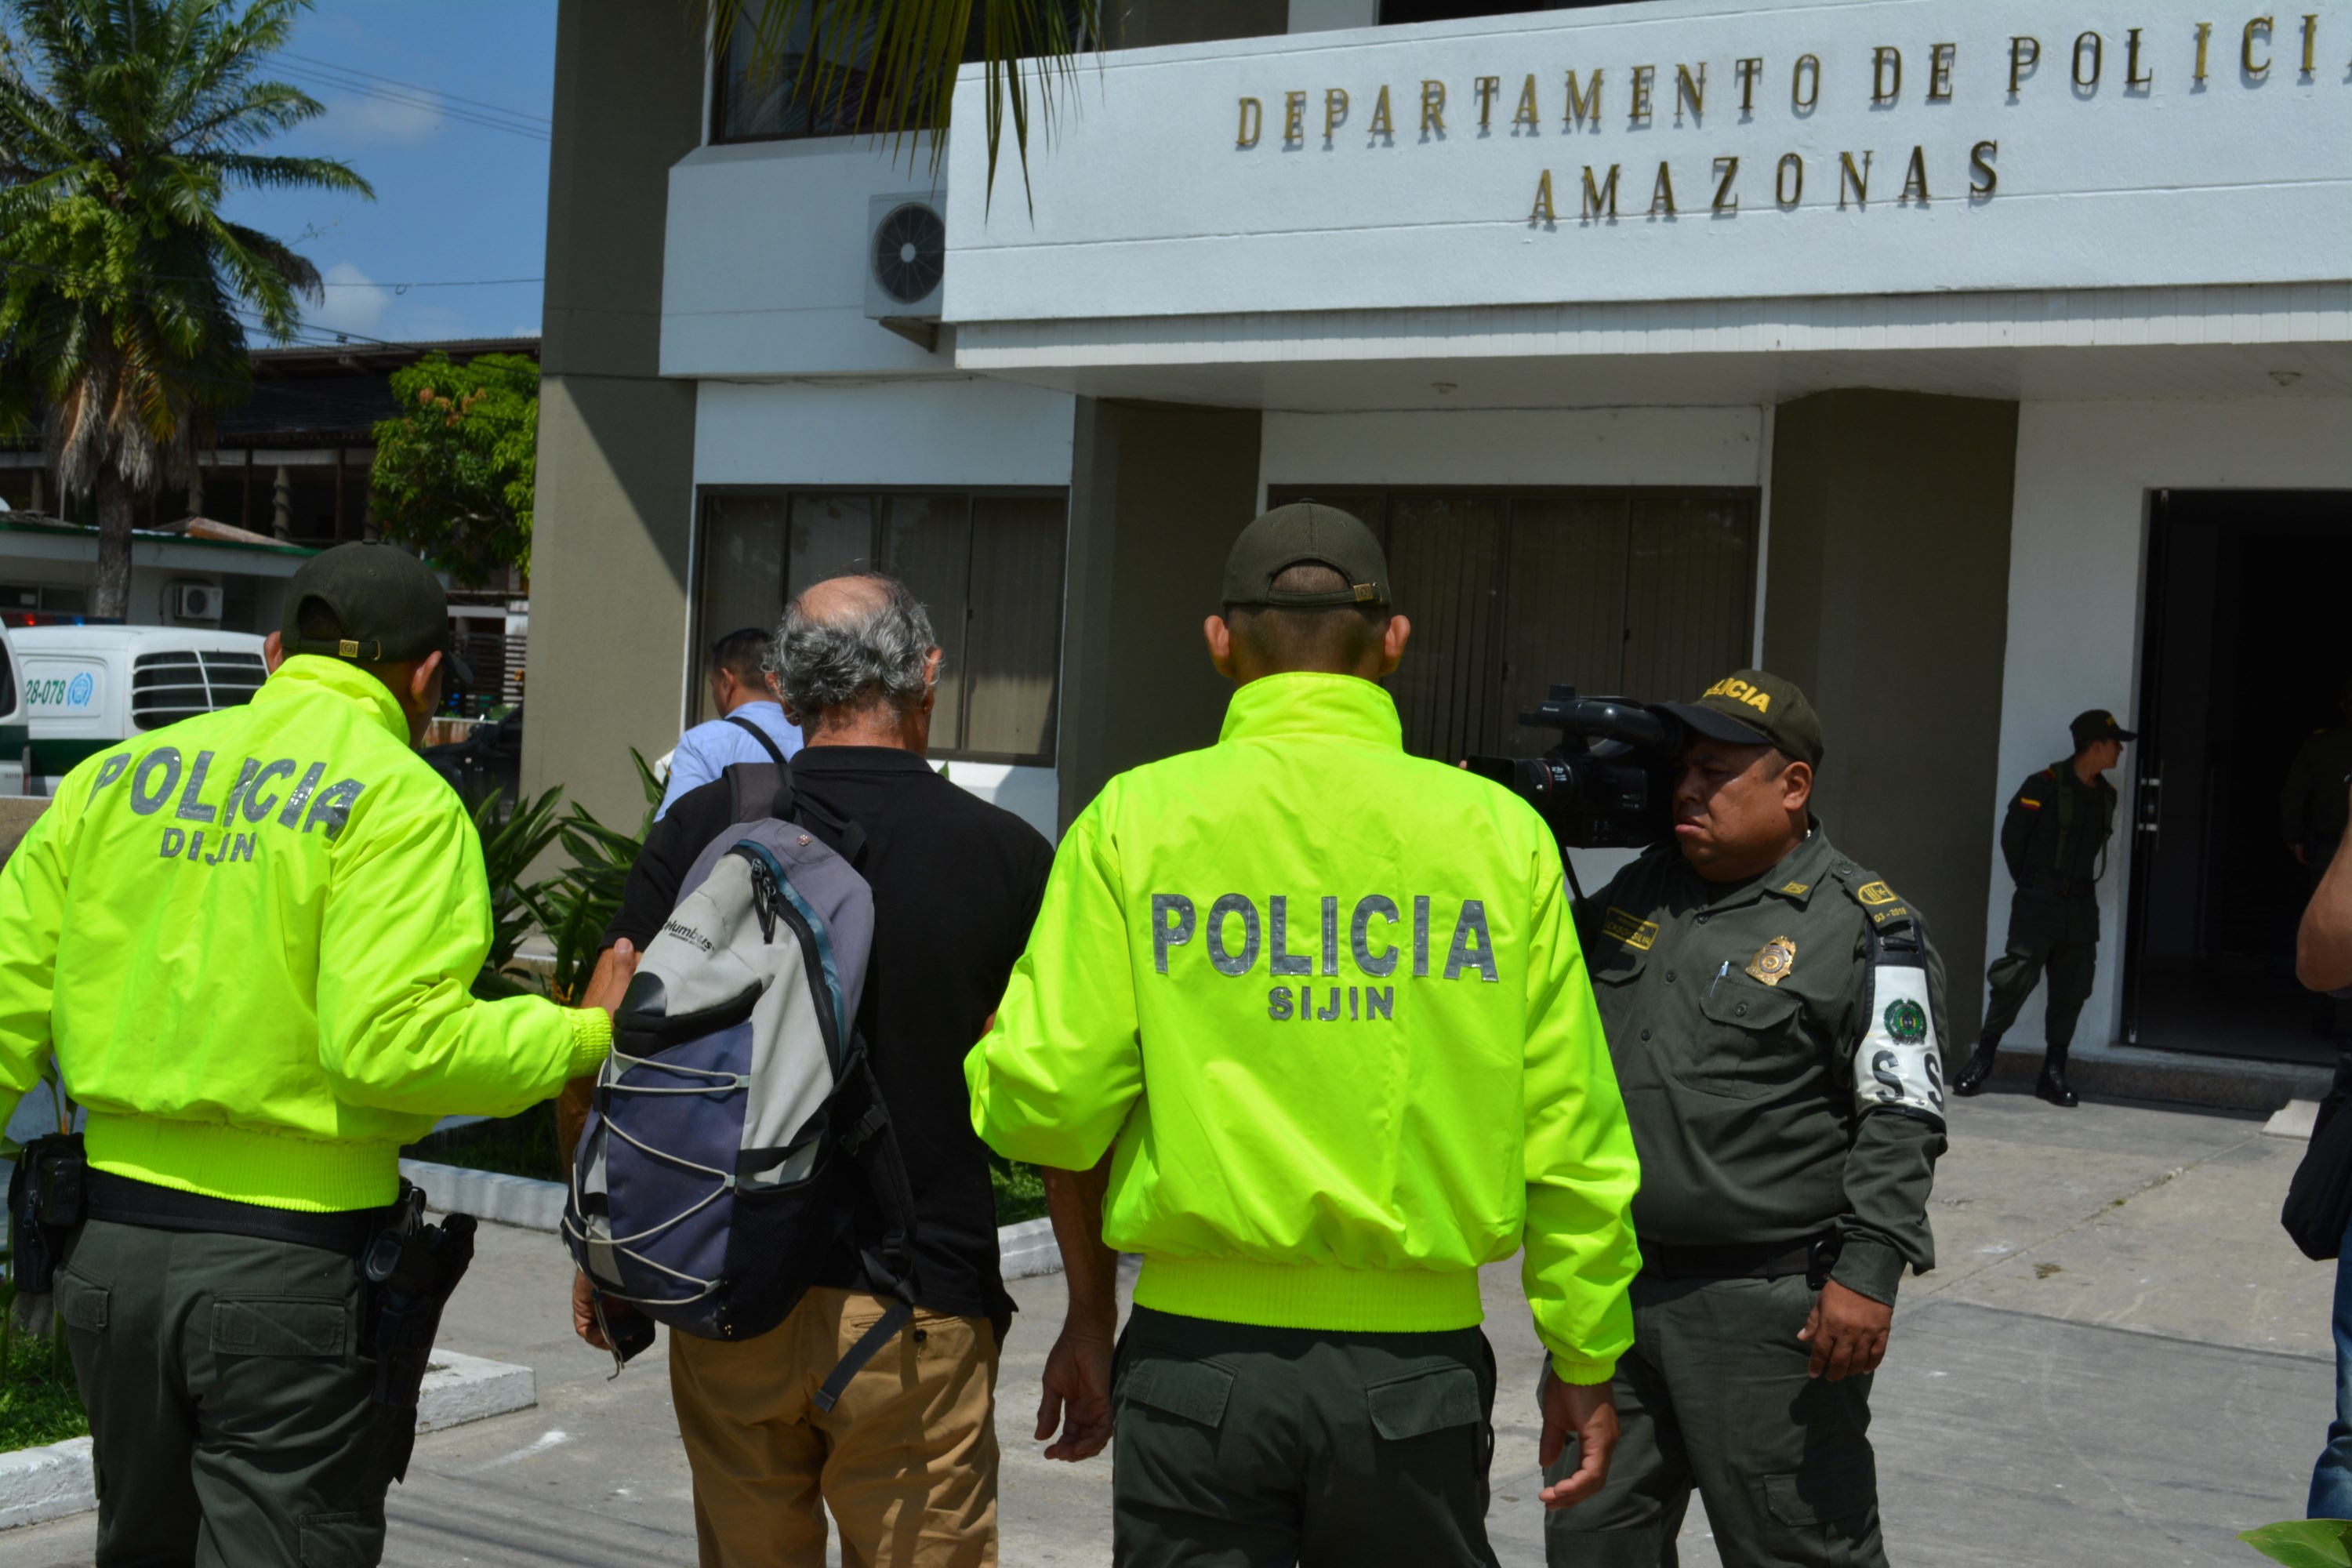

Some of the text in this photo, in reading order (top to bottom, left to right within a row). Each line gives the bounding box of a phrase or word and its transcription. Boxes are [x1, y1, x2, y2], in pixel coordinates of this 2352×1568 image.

[1236, 14, 2352, 147] DEPARTAMENTO DE POLICI
[1529, 140, 1998, 220] AMAZONAS
[27, 680, 67, 705] 28-078
[1703, 677, 1770, 713] LICIA
[83, 746, 366, 843] POLICIA
[1151, 892, 1500, 983] POLICIA
[1268, 985, 1395, 1021] SIJIN
